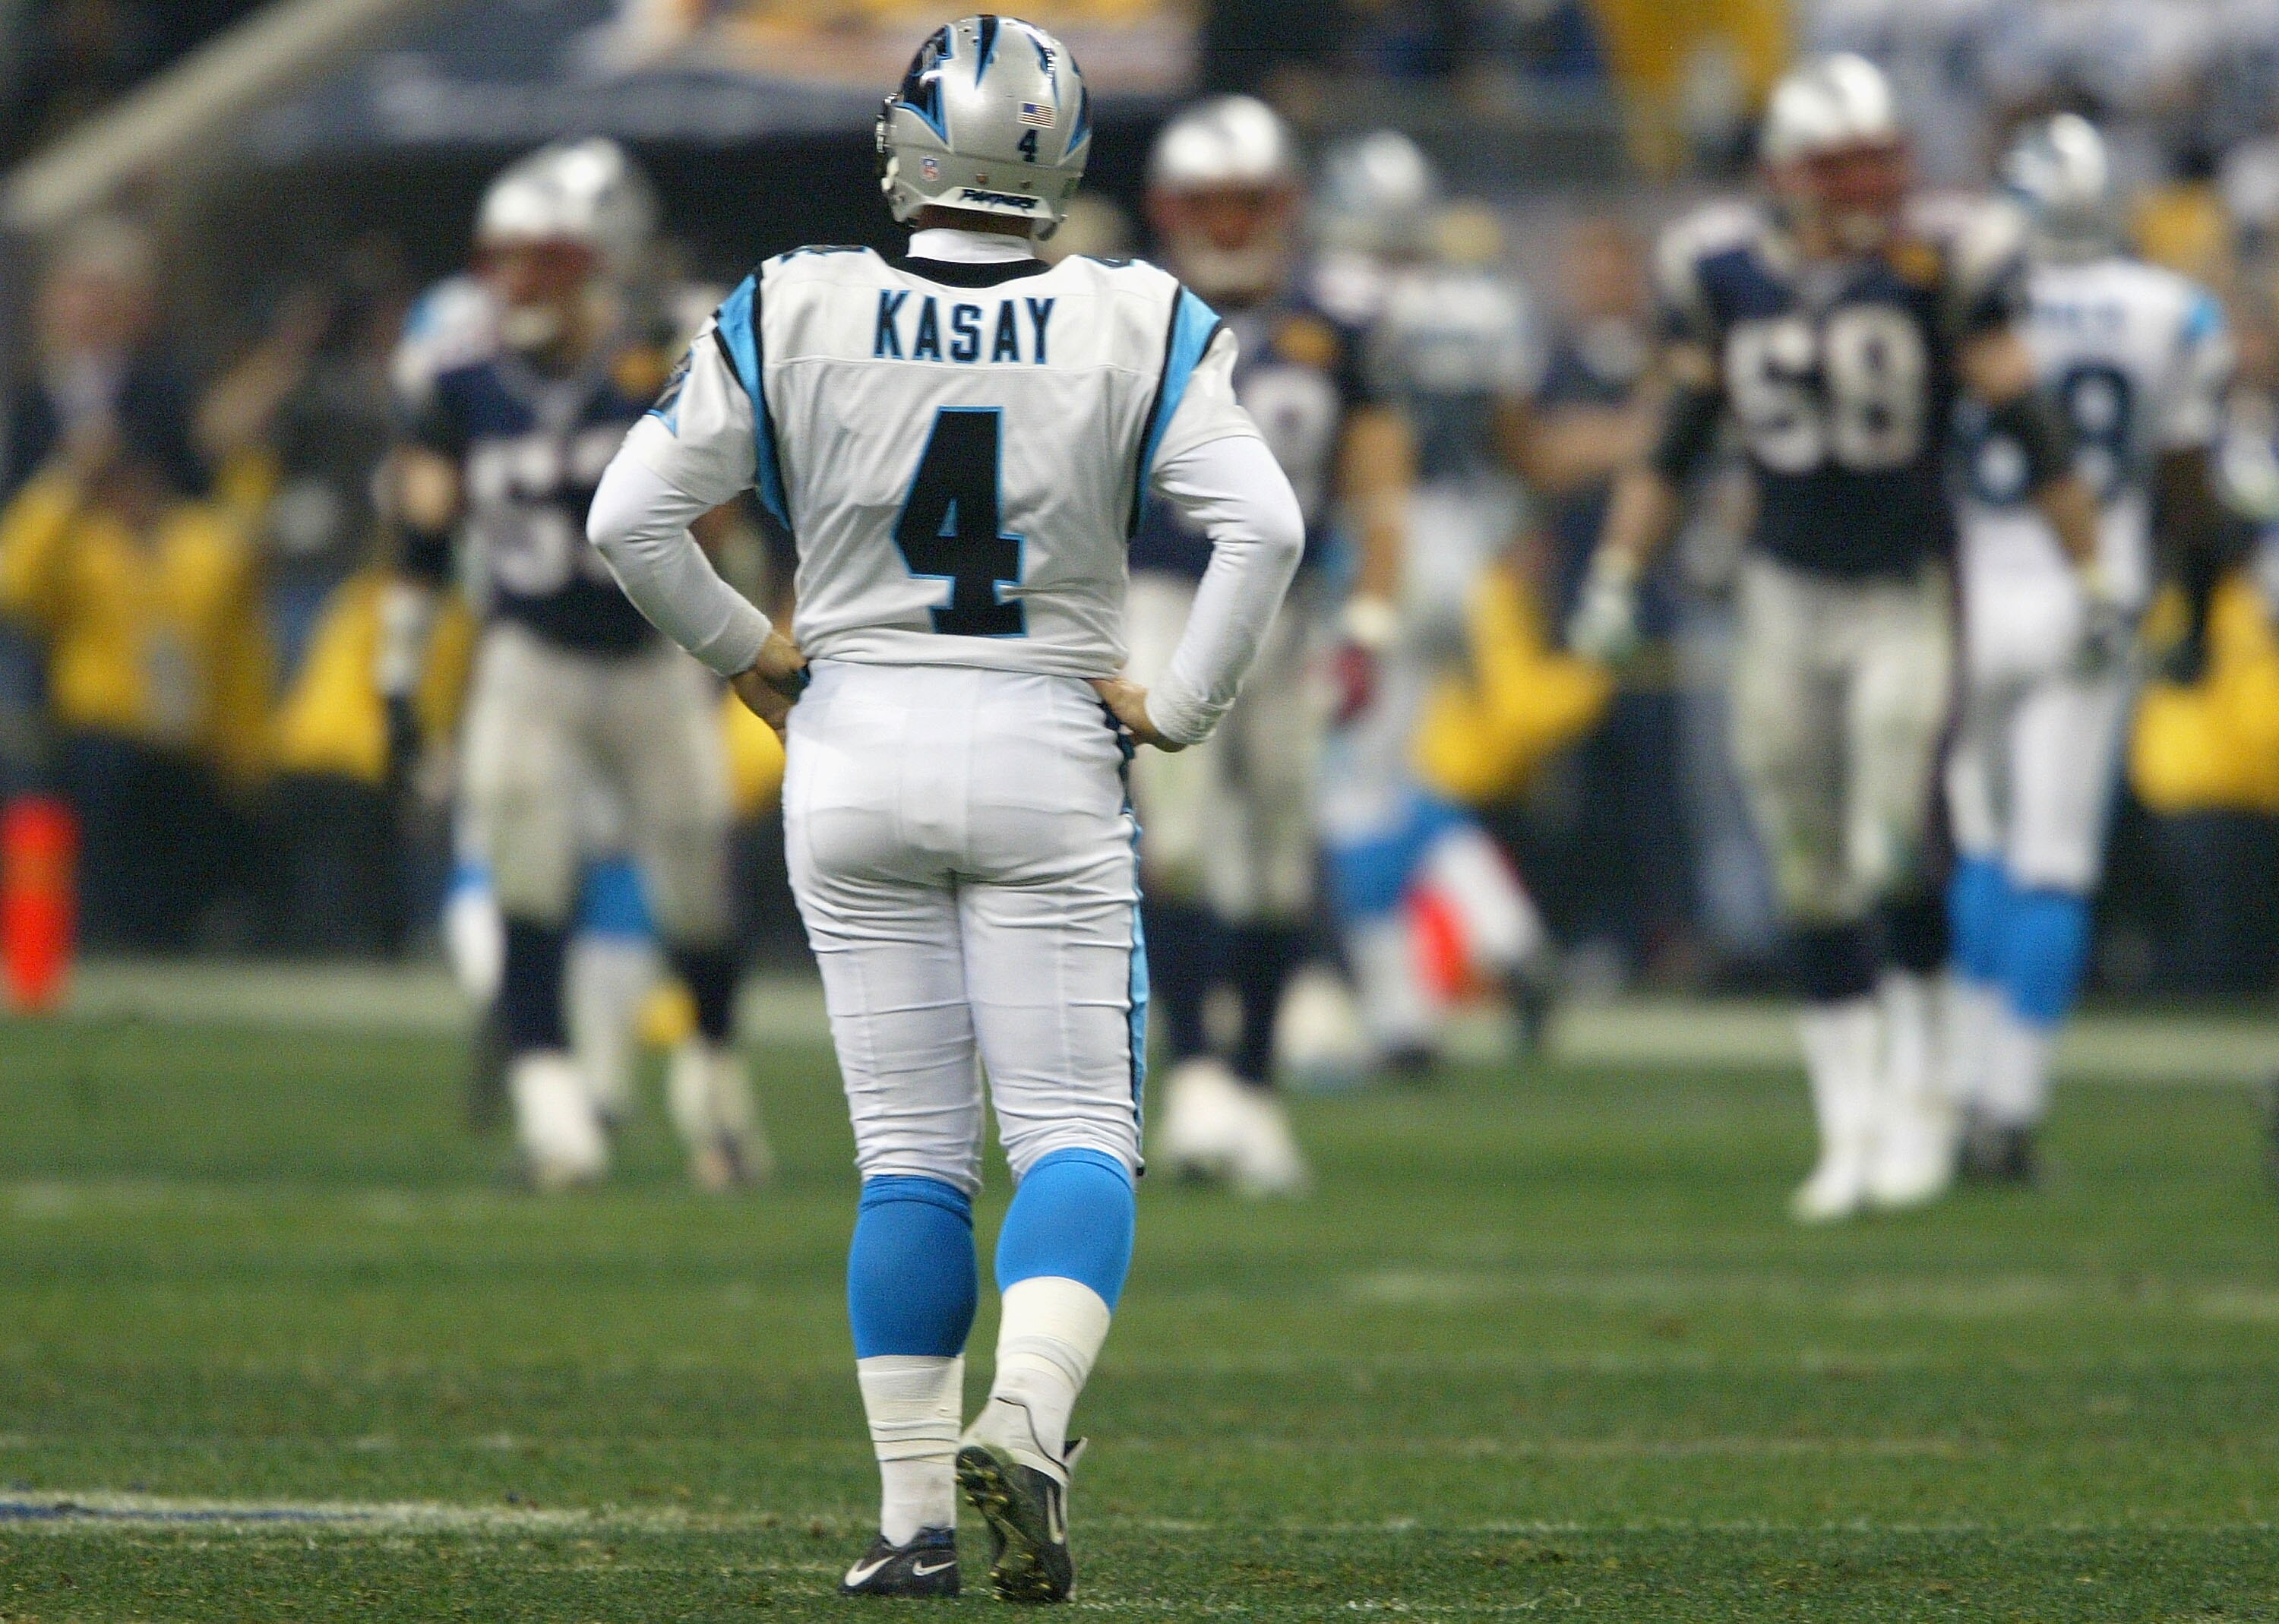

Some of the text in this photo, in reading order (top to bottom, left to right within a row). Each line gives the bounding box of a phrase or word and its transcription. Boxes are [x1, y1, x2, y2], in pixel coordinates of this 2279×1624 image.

[1017, 128, 1038, 163] 4
[873, 289, 1057, 365] KASAY
[1724, 304, 1930, 474] 58
[890, 406, 1029, 638] 4
